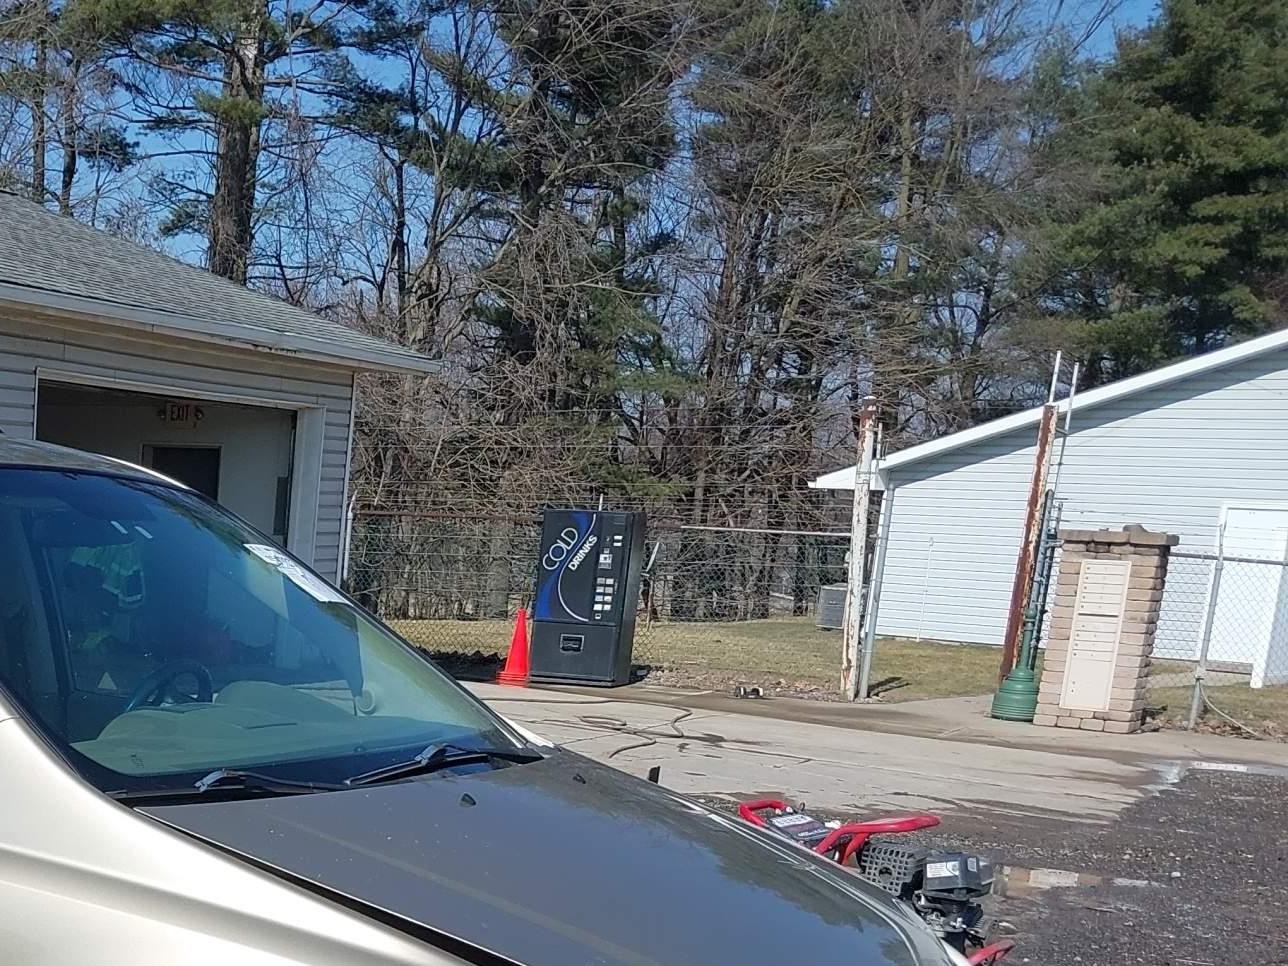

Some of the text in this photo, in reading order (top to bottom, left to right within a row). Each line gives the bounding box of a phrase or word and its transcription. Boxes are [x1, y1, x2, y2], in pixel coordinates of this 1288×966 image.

[170, 404, 192, 422] EXIT
[542, 527, 579, 570] COLD
[568, 534, 598, 571] DRINKS
